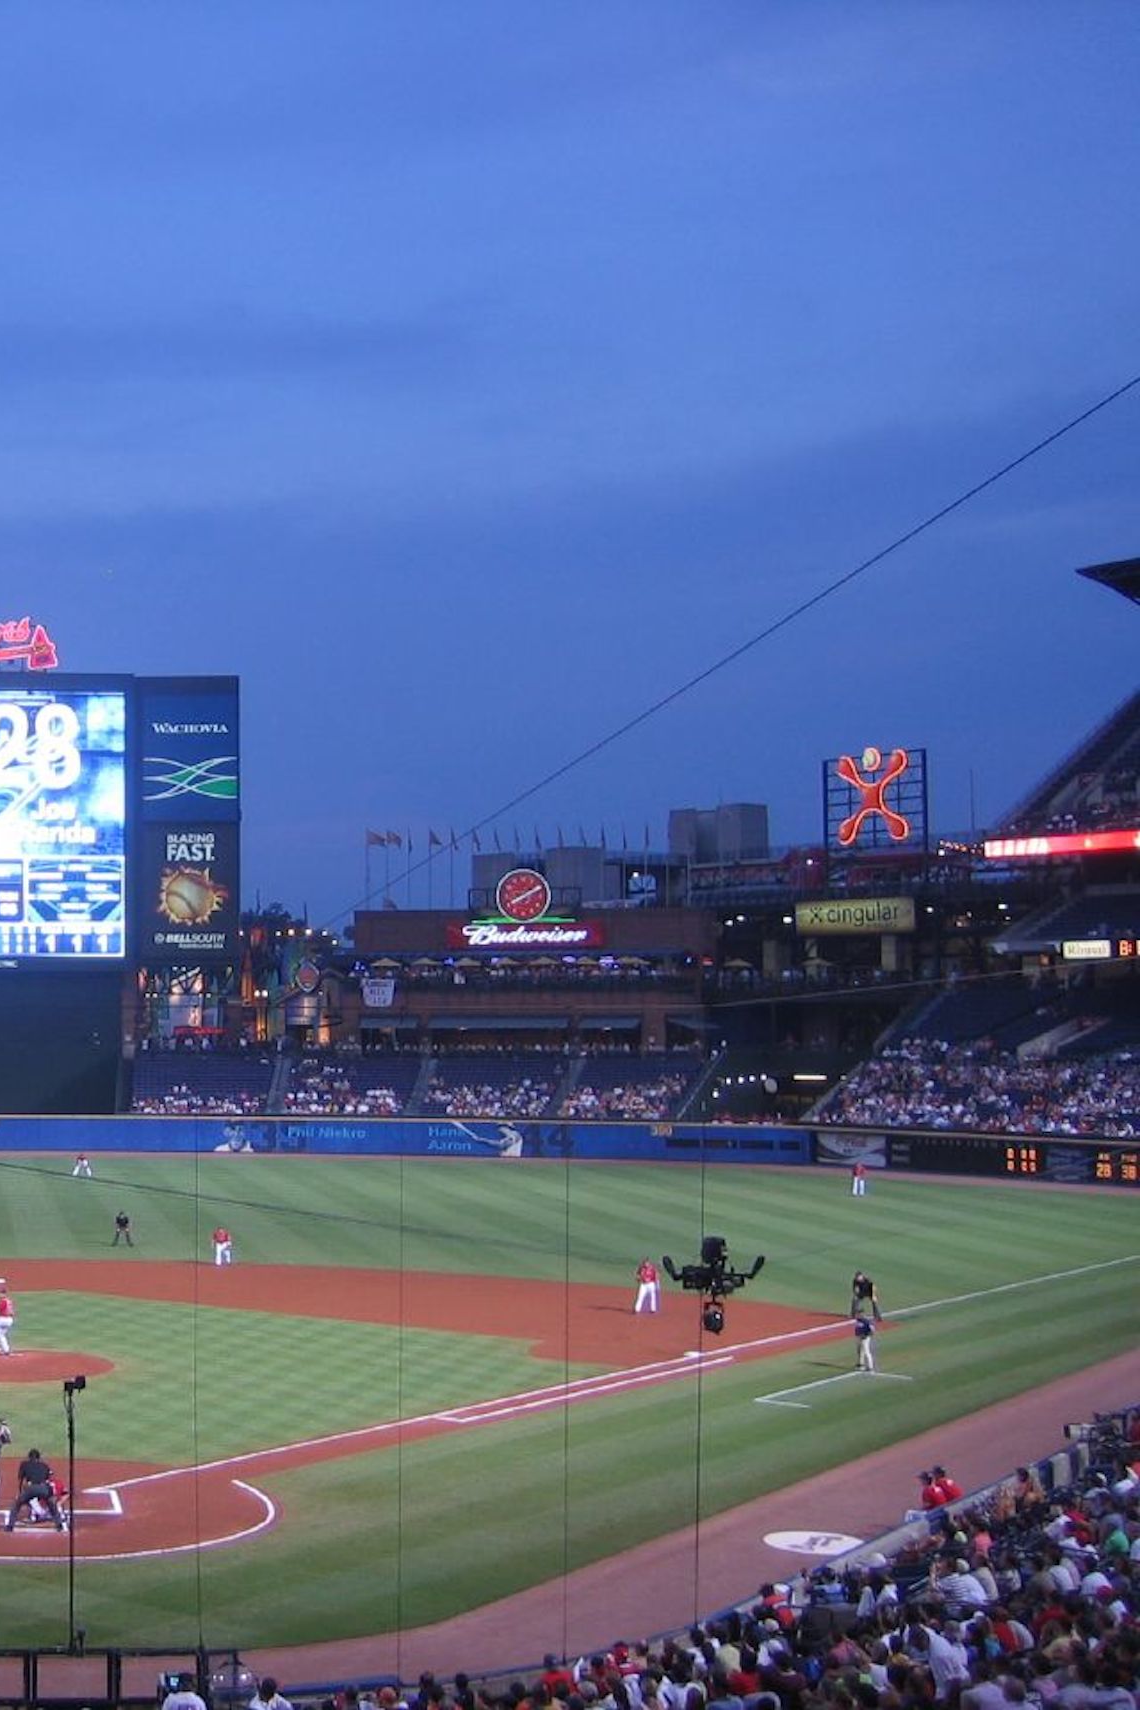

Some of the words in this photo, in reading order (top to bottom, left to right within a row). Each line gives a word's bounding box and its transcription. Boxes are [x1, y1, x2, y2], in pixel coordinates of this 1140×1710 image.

[153, 722, 229, 734] WACHOVIA
[167, 833, 215, 843] BLAZING
[167, 844, 215, 862] FAST.
[827, 901, 898, 927] cingular
[166, 932, 226, 944] BELLSOUTH
[462, 924, 587, 945] Budweiser
[287, 1125, 316, 1138] Phil
[319, 1125, 366, 1139] Niekro
[427, 1139, 472, 1151] Aaron
